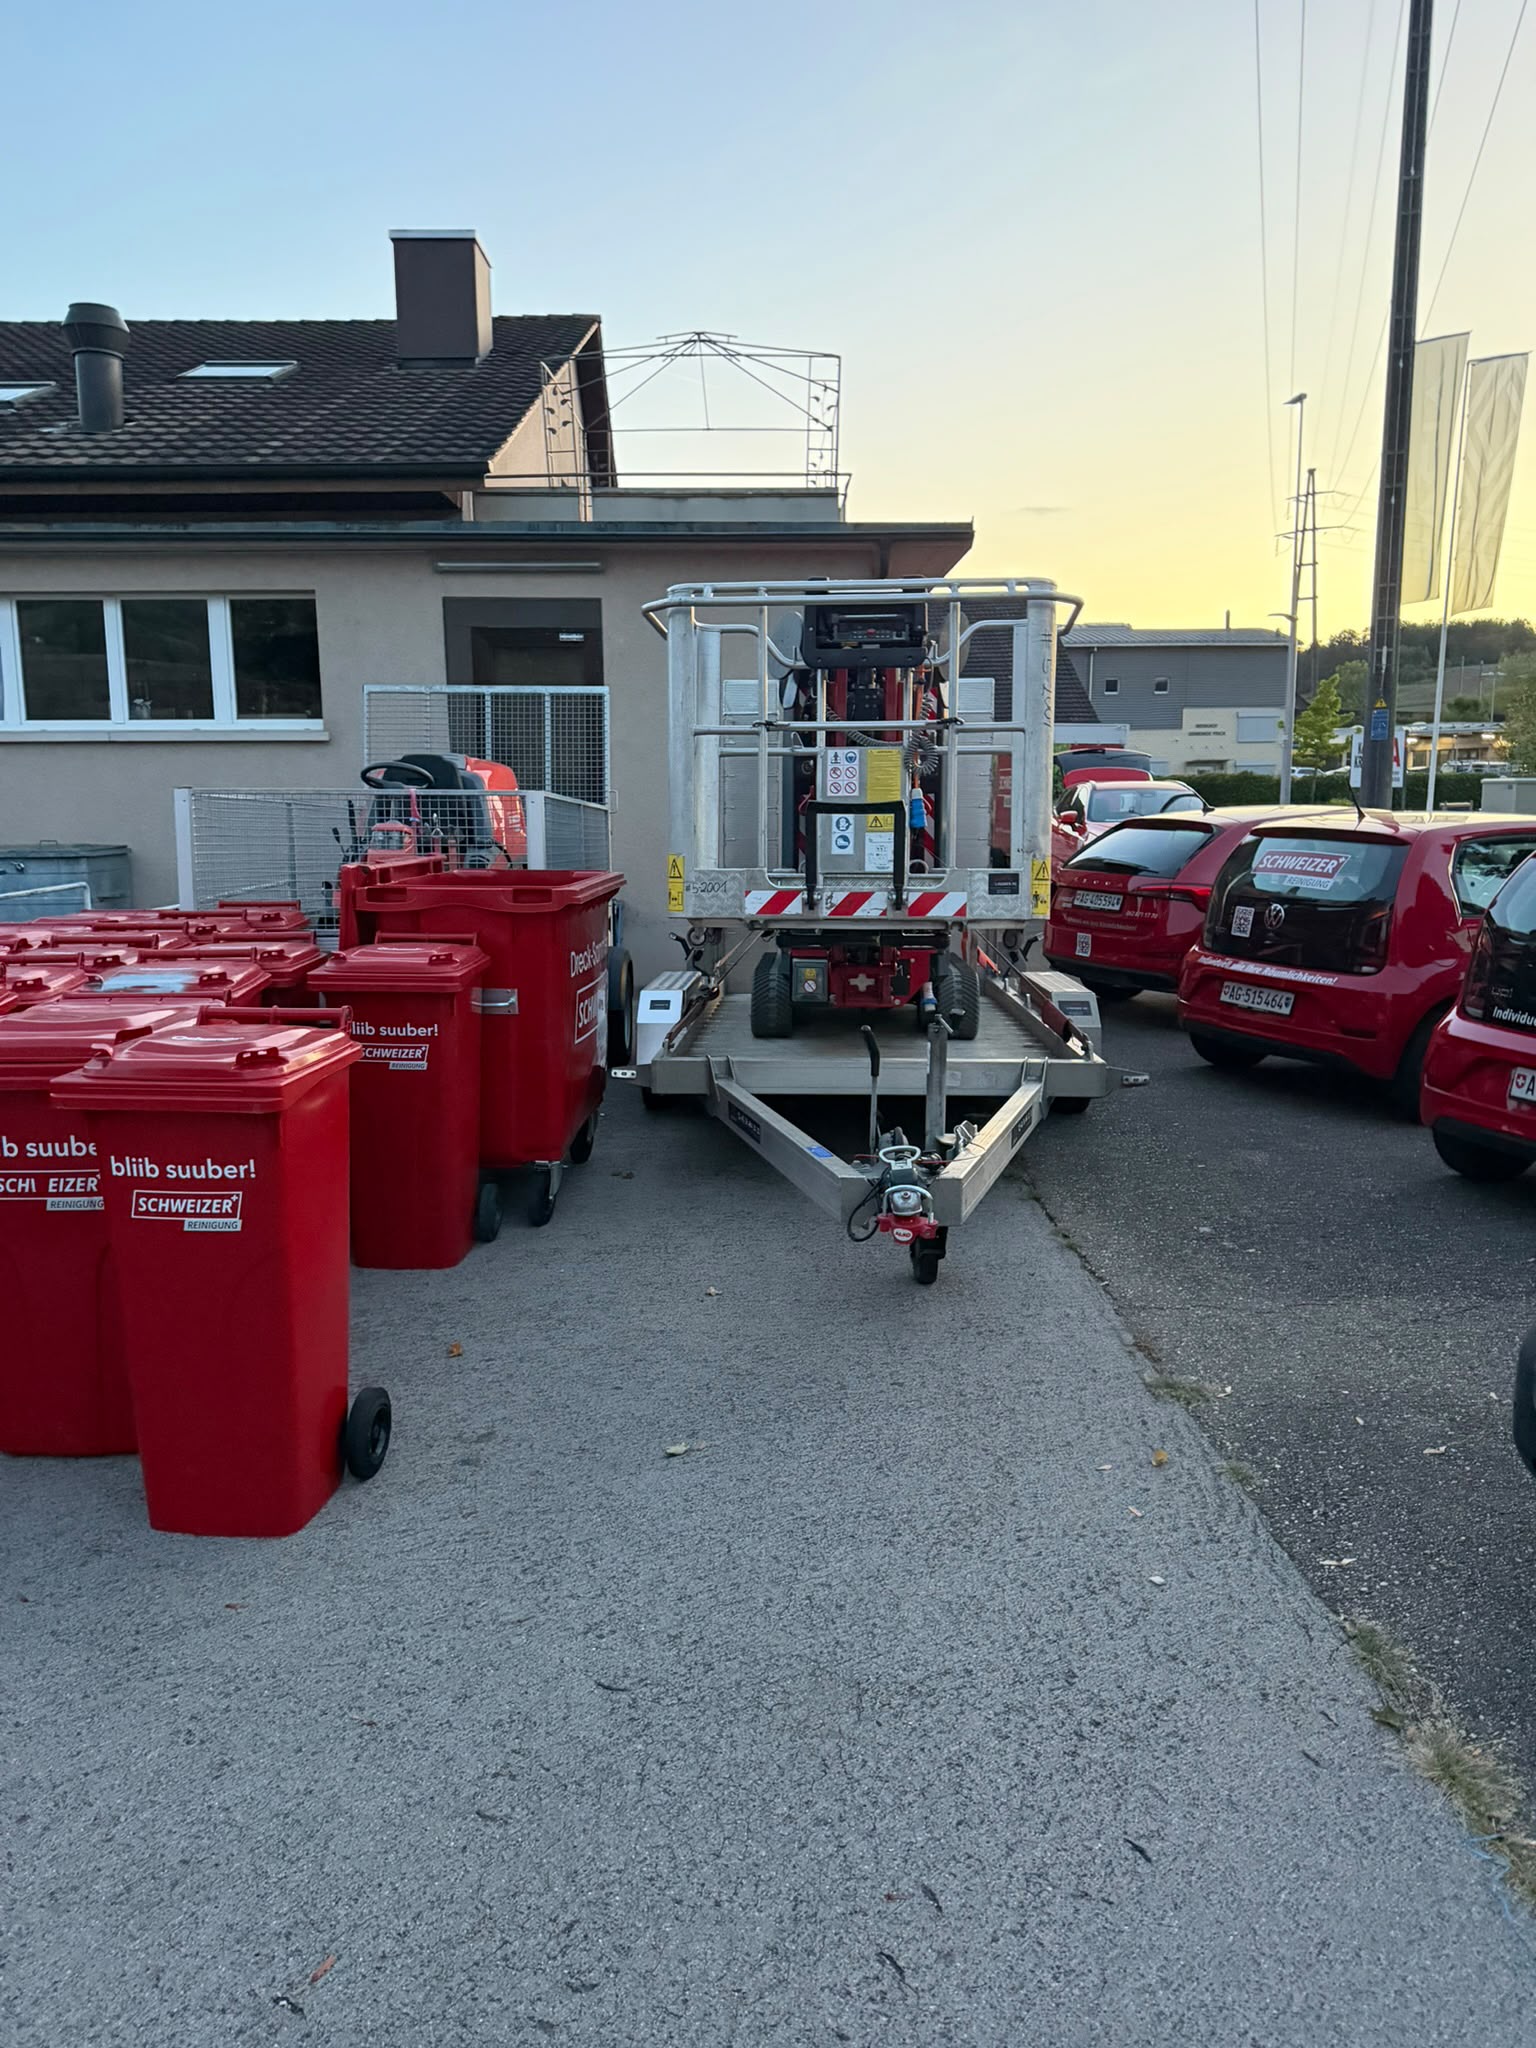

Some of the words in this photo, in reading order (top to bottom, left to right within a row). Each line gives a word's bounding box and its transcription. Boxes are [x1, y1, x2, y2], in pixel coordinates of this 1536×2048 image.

[1259, 855, 1338, 874] SCHWEIZER
[1286, 875, 1331, 889] REINIGUNG
[352, 1021, 375, 1035] liib
[379, 1022, 438, 1037] suuber!
[25, 1135, 97, 1157] suube
[110, 1155, 160, 1177] bliib
[166, 1158, 256, 1179] suuber!
[50, 1200, 104, 1209] REINIGUNG
[137, 1197, 233, 1214] SCHWEIZER
[187, 1221, 238, 1230] REINIGUNG
